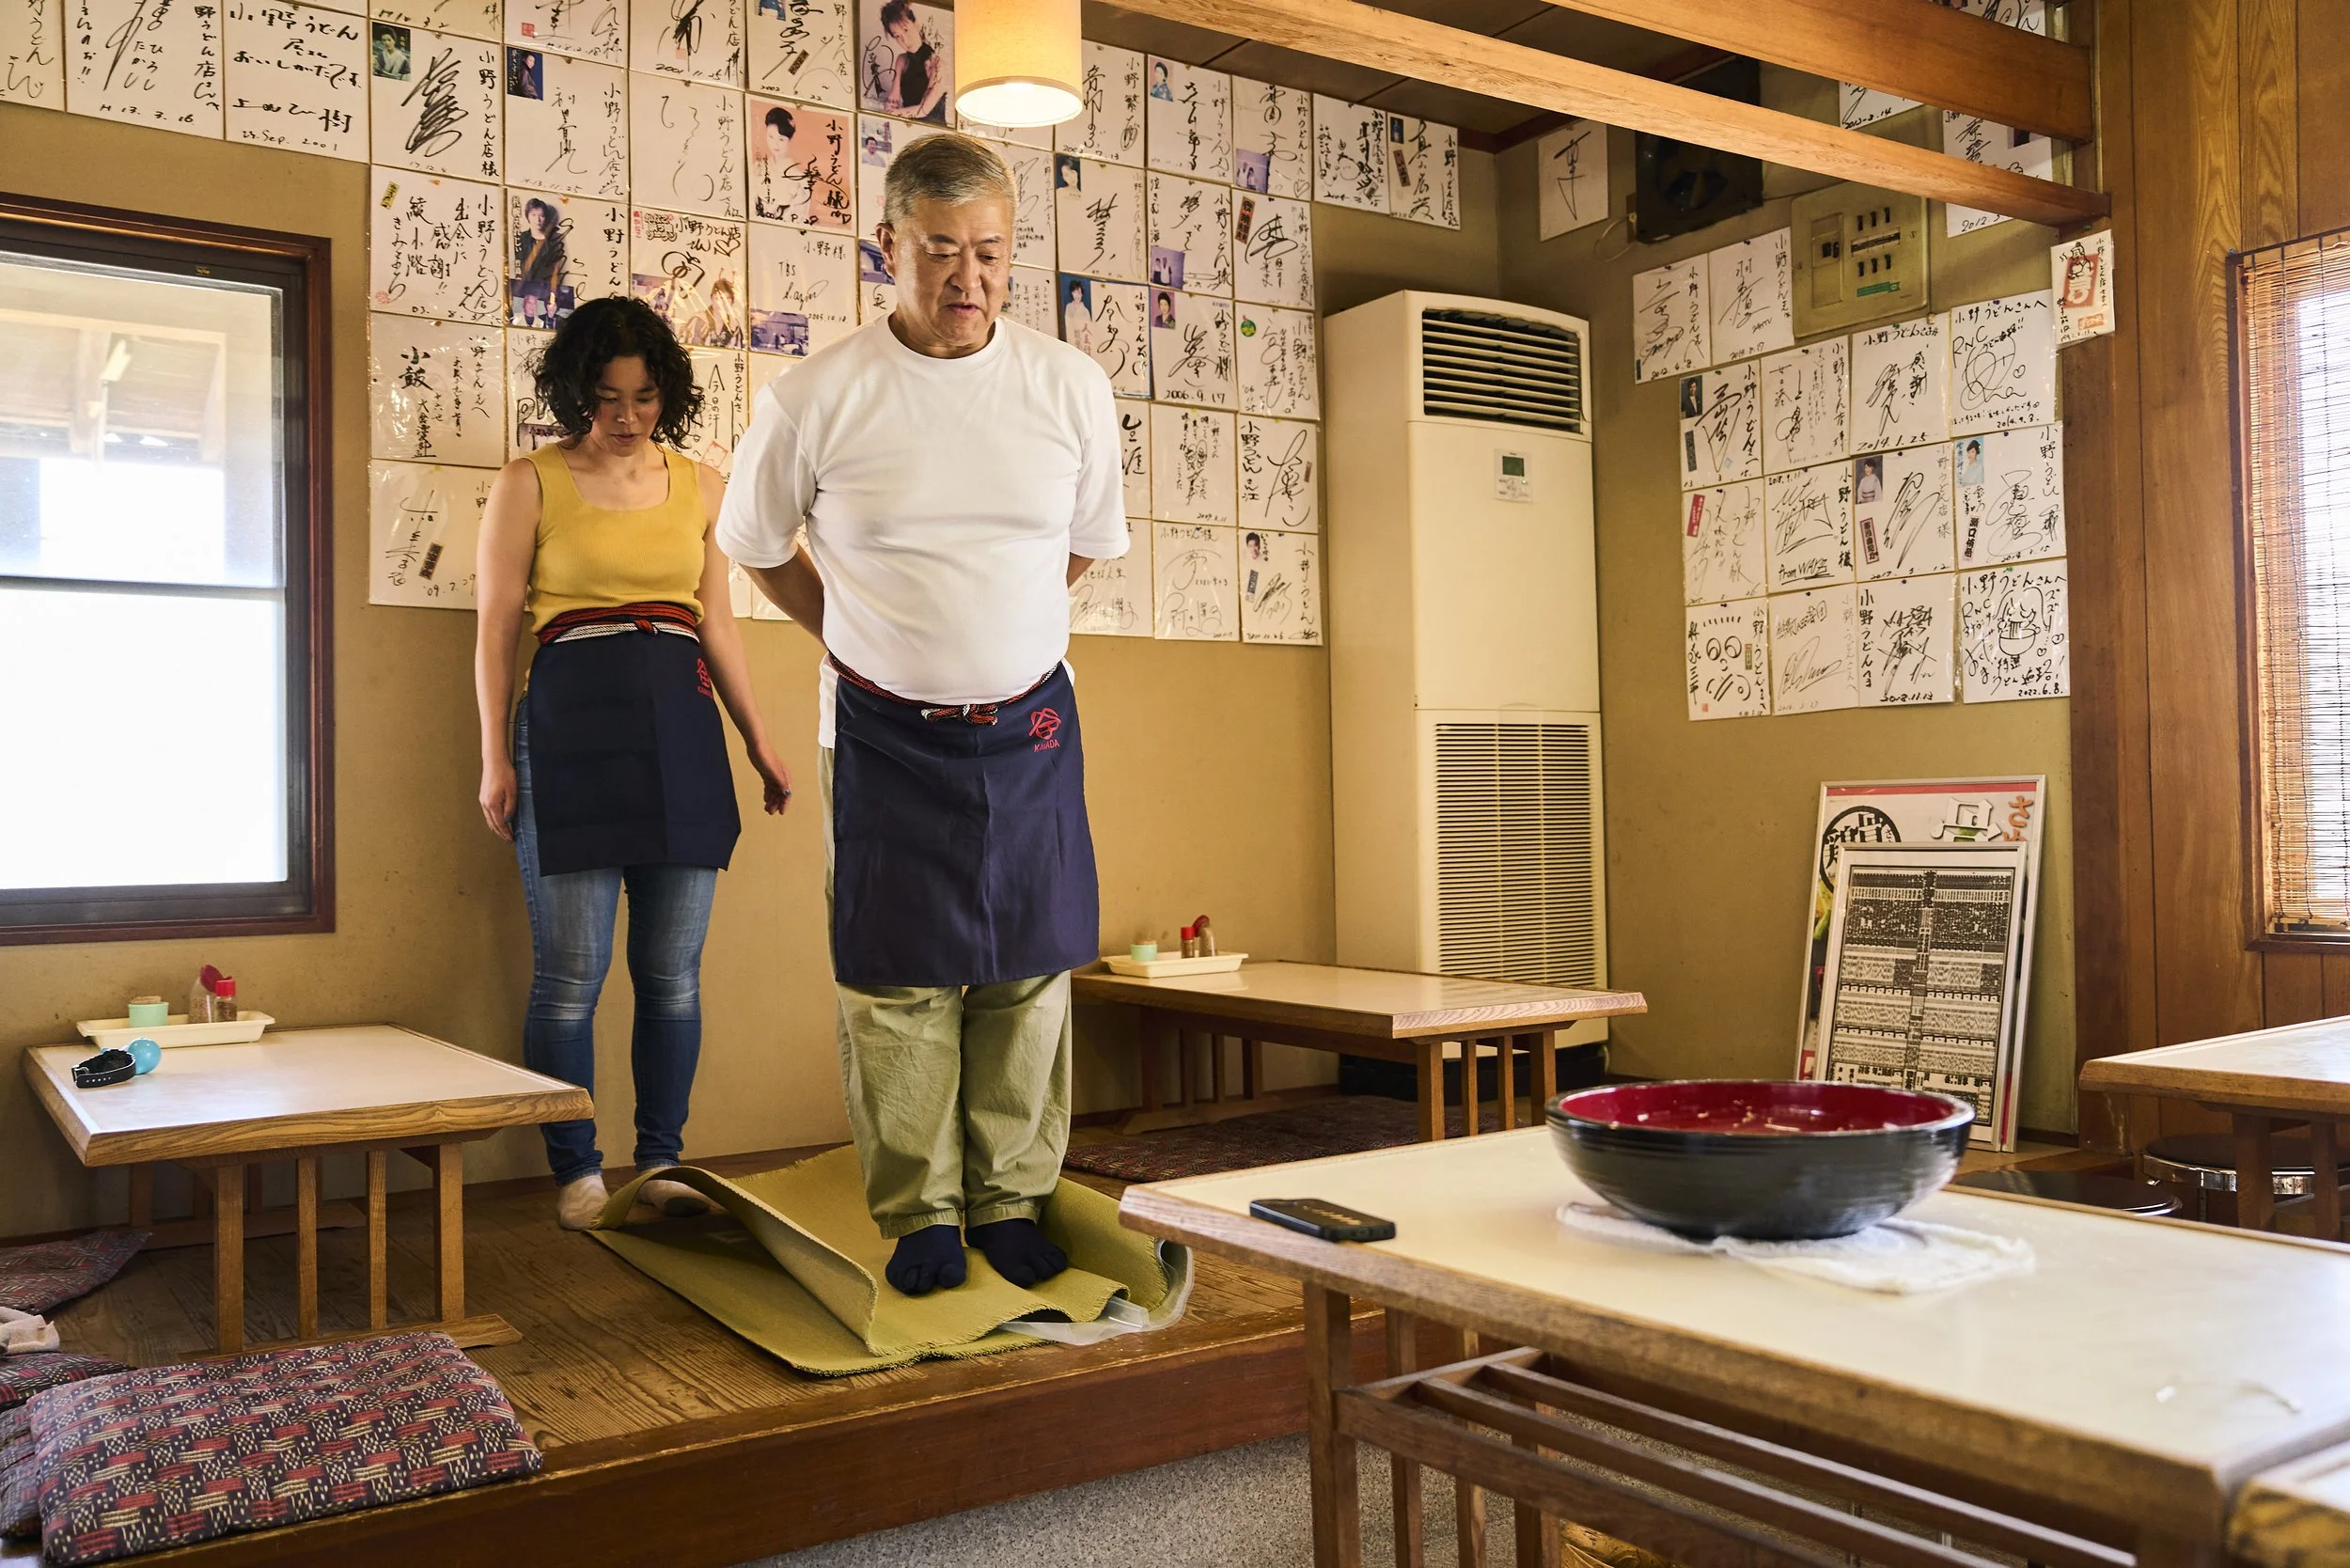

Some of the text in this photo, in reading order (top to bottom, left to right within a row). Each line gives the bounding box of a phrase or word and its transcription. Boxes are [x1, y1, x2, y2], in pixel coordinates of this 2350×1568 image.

[478, 50, 500, 178] 小野うどん店様
[302, 137, 339, 152] 2001
[778, 261, 797, 277] TBS
[1954, 299, 2048, 324] 小野うどんさんへ
[1952, 325, 1989, 369] RNC
[398, 346, 434, 391] 小鼓
[1838, 466, 1854, 572] 小野うどん様
[1962, 570, 2067, 598] 小野うどんさんへ
[1962, 598, 1992, 629] RNC
[2018, 682, 2064, 698] 2022.6.8.
